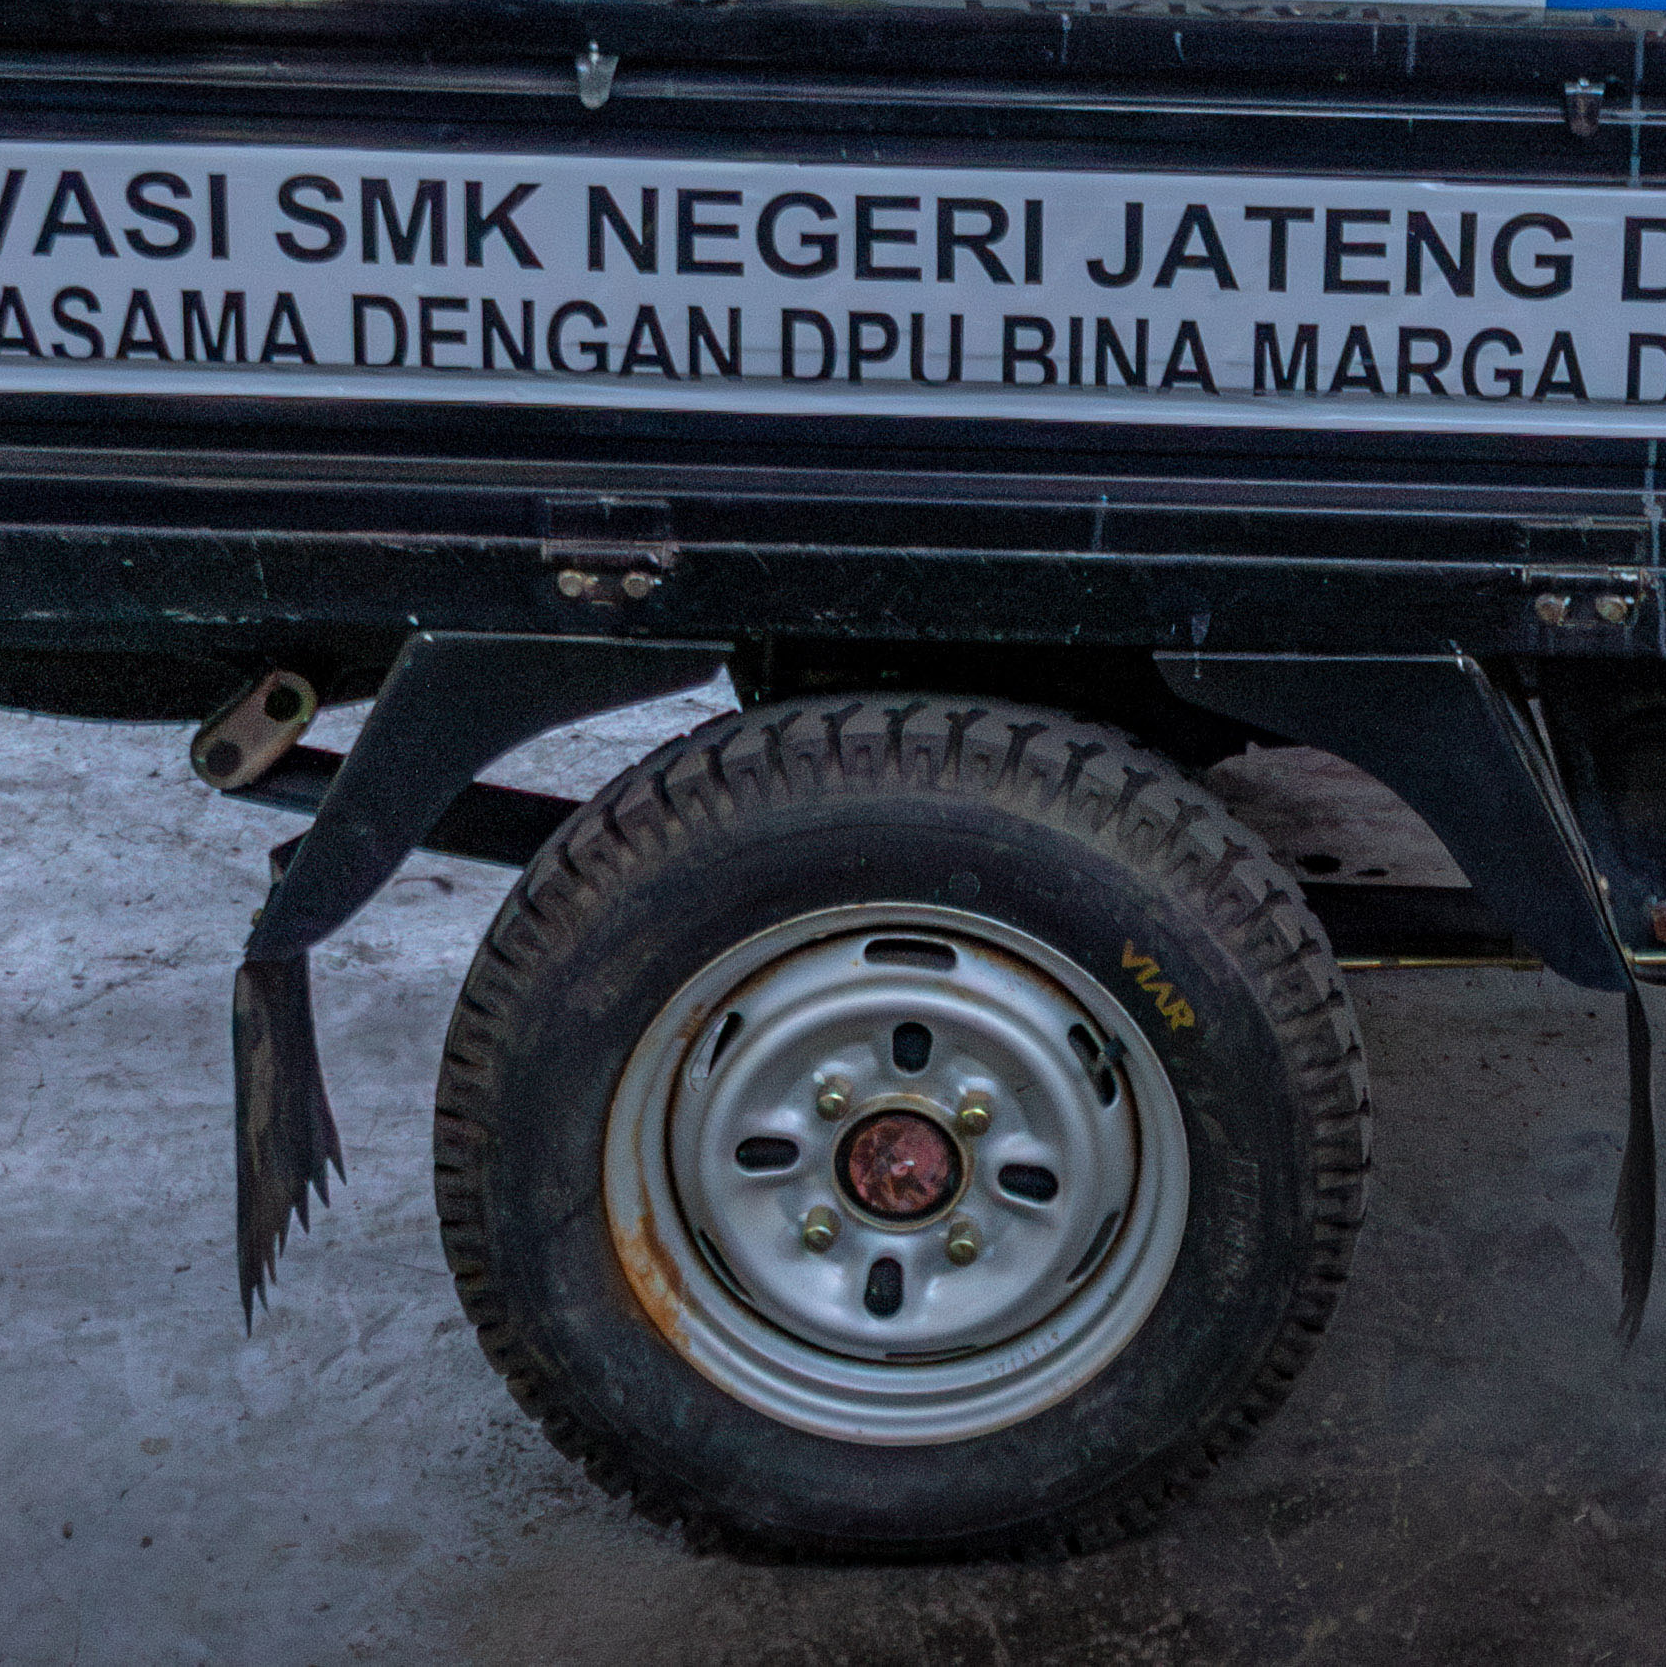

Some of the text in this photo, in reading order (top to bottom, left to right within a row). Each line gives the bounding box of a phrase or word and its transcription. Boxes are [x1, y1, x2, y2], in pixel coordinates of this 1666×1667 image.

[275, 175, 545, 271] SMK
[586, 184, 1043, 286] NEGERI
[1085, 200, 1574, 300] JATENG
[351, 293, 742, 382] DENGAN
[780, 308, 965, 386] DPU
[1001, 314, 1221, 396] BINA
[1252, 320, 1591, 402] MARGA
[1121, 938, 1196, 1031] VIAR
